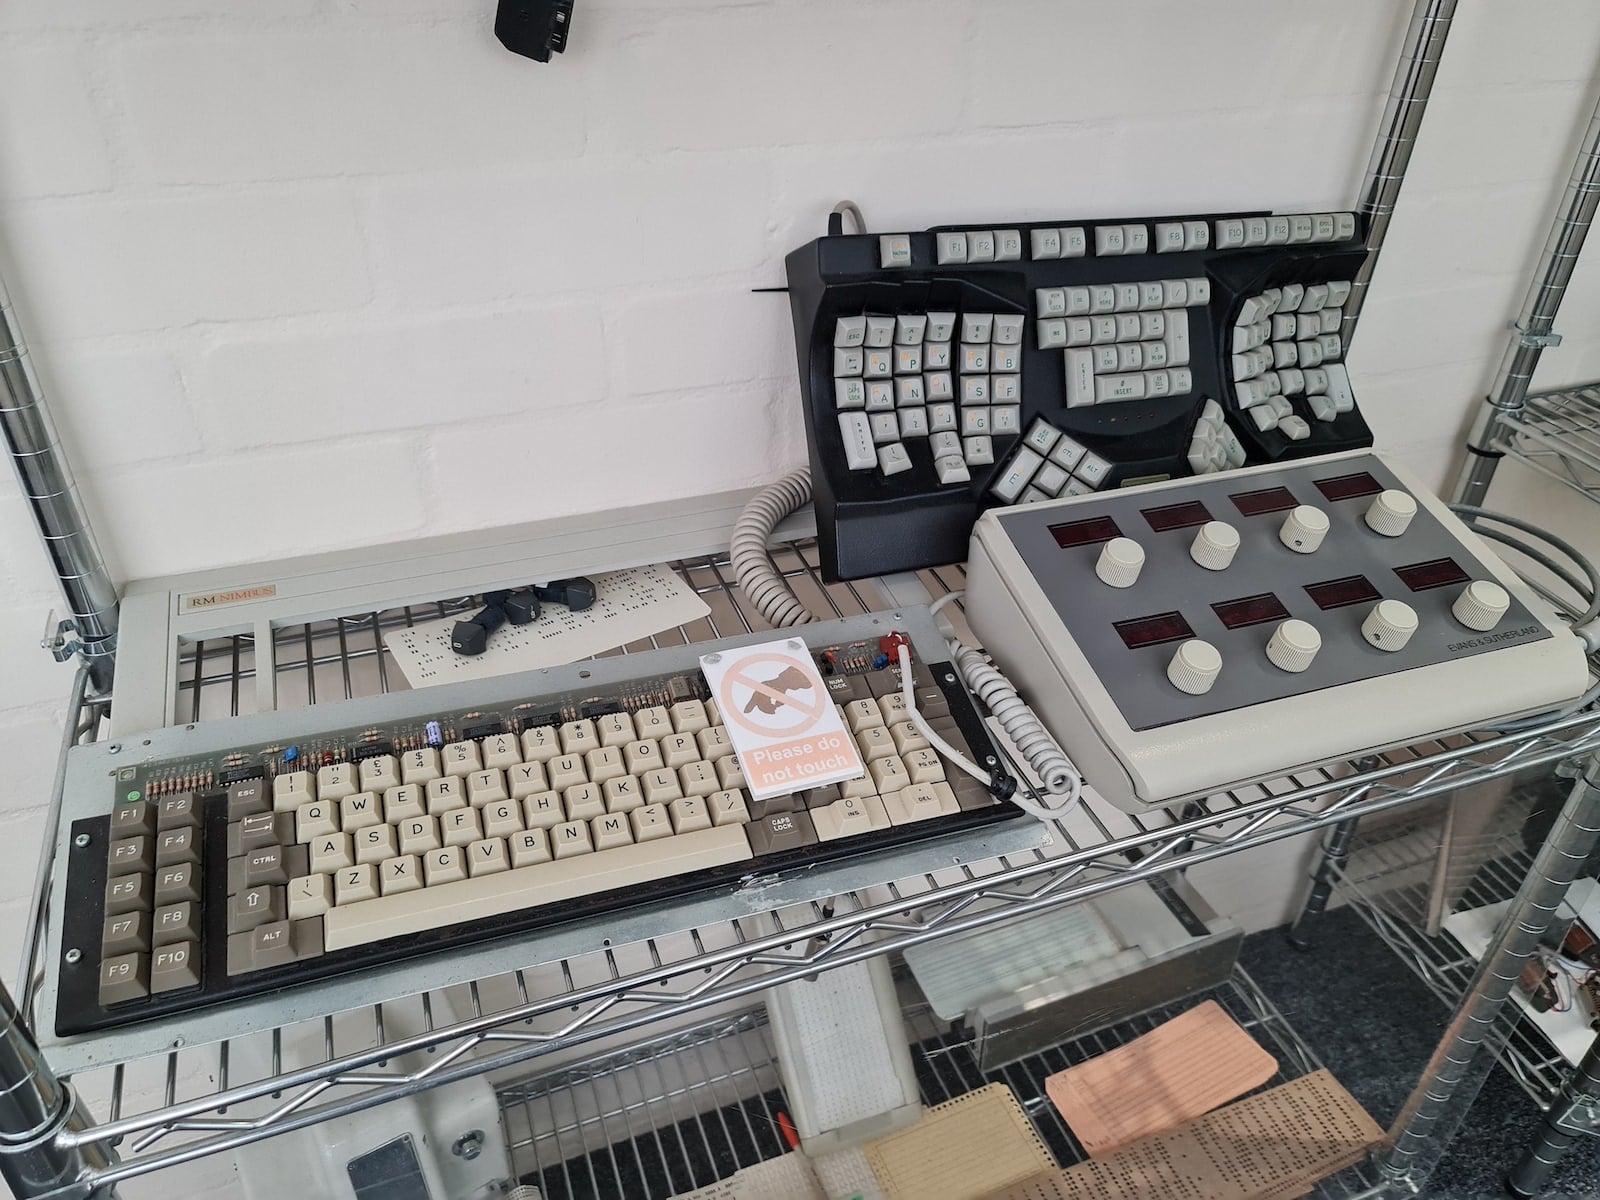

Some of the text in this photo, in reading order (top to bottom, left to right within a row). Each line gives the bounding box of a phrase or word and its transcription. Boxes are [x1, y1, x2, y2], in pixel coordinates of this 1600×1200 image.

[1229, 228, 1240, 236] F10
[953, 243, 960, 252] F1
[979, 242, 989, 250] F2
[1006, 240, 1016, 248] F3
[939, 354, 945, 363] Y
[976, 358, 982, 367] C
[1006, 359, 1012, 368] B
[879, 362, 886, 371] Q
[910, 360, 916, 368] P
[912, 389, 918, 398] N
[976, 387, 982, 396] S
[1007, 387, 1012, 396] F
[881, 394, 888, 402] A
[947, 414, 950, 423] J
[977, 418, 983, 428] G
[1062, 448, 1073, 458] CTL
[1087, 464, 1098, 473] ALT
[1009, 473, 1019, 484] E
[193, 596, 215, 606] RM
[1448, 641, 1478, 652] EVANS
[1484, 626, 1539, 644] SUTHERLAND
[676, 739, 684, 748] P
[639, 746, 649, 755] O
[753, 737, 840, 765] Please do
[416, 752, 422, 760] $
[604, 753, 608, 762] I
[562, 760, 572, 770] U
[762, 753, 848, 785] not touch
[522, 768, 532, 778] Y
[480, 775, 490, 785] T
[657, 775, 666, 785] L
[440, 783, 449, 794] R
[618, 782, 629, 793] K
[398, 791, 408, 802] E
[582, 789, 590, 800] J
[166, 800, 186, 810] F2
[352, 799, 366, 810] W
[538, 799, 548, 809] H
[120, 810, 137, 820] F1
[310, 807, 320, 818] Q
[498, 807, 508, 818] G
[455, 815, 464, 825] F
[606, 819, 619, 830] M
[772, 817, 790, 826] CAPS
[412, 824, 423, 834] D
[773, 822, 793, 831] LOCK
[369, 832, 379, 842] S
[566, 827, 577, 839] N
[165, 835, 184, 846] F4
[525, 836, 535, 847] B
[116, 845, 136, 857] F3
[324, 841, 335, 852] A
[481, 845, 493, 856] V
[253, 855, 276, 864] CTRL
[439, 854, 449, 865] C
[394, 864, 405, 876] X
[164, 872, 183, 884] F6
[350, 873, 360, 884] Z
[113, 882, 134, 894] F5
[163, 911, 182, 923] F8
[112, 921, 131, 933] F7
[263, 931, 281, 941] ALT
[158, 951, 184, 965] F10
[109, 963, 129, 976] F9
